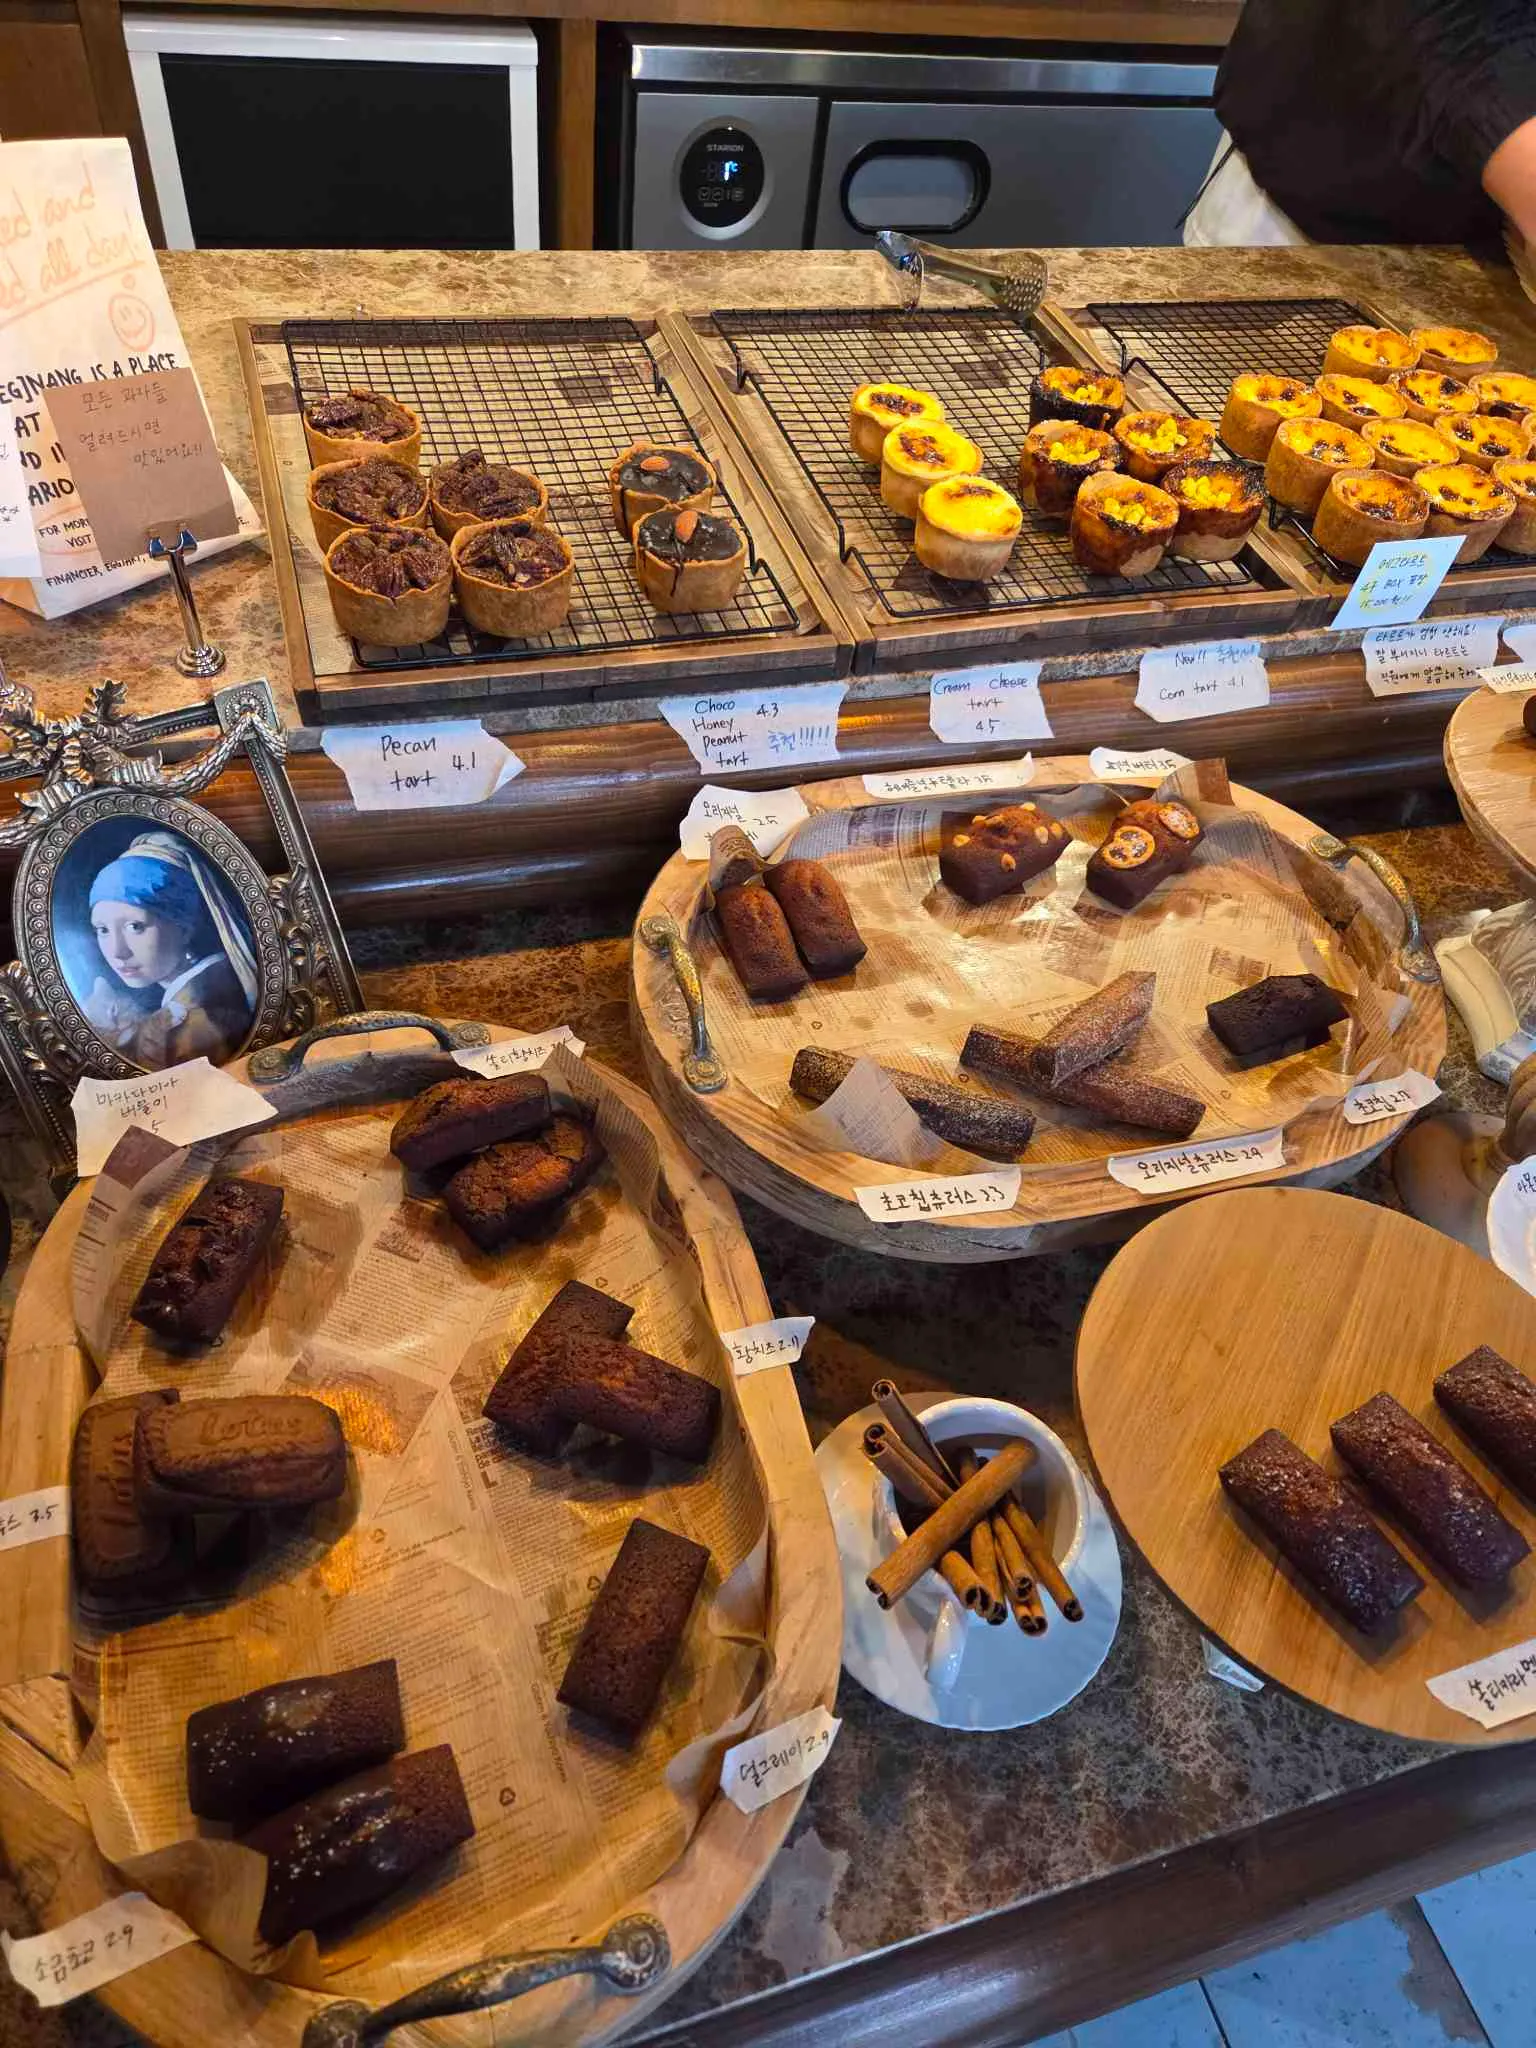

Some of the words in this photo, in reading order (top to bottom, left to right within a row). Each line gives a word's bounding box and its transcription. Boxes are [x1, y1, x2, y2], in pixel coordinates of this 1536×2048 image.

[45, 161, 95, 228] and
[40, 237, 82, 292] all
[91, 364, 107, 381] IS
[112, 361, 124, 379] A
[128, 353, 179, 376] PLACE
[81, 391, 112, 413] 모든
[39, 523, 61, 538] FOR
[67, 534, 93, 548] VISIT
[934, 678, 971, 695] Cream
[1160, 688, 1185, 700] Corn
[1193, 679, 1220, 694] tart
[694, 700, 736, 714] Choco
[756, 702, 779, 718] 4.3
[966, 697, 1005, 710] tart
[692, 716, 734, 733] Honey
[382, 734, 437, 761] Pecan
[452, 752, 477, 771] 4.1
[716, 752, 749, 768] tart
[389, 770, 438, 792] tart
[703, 800, 747, 823] 오리지널
[96, 1077, 181, 1106] 마카다미아
[1353, 1093, 1397, 1116] 초코칩
[151, 1119, 167, 1134] 5
[1137, 1149, 1239, 1180] 오리지널츄러스
[880, 1186, 977, 1213] 초코칩츄러스
[732, 1340, 777, 1364] 황치즈
[740, 1739, 803, 1788] 얼그레이
